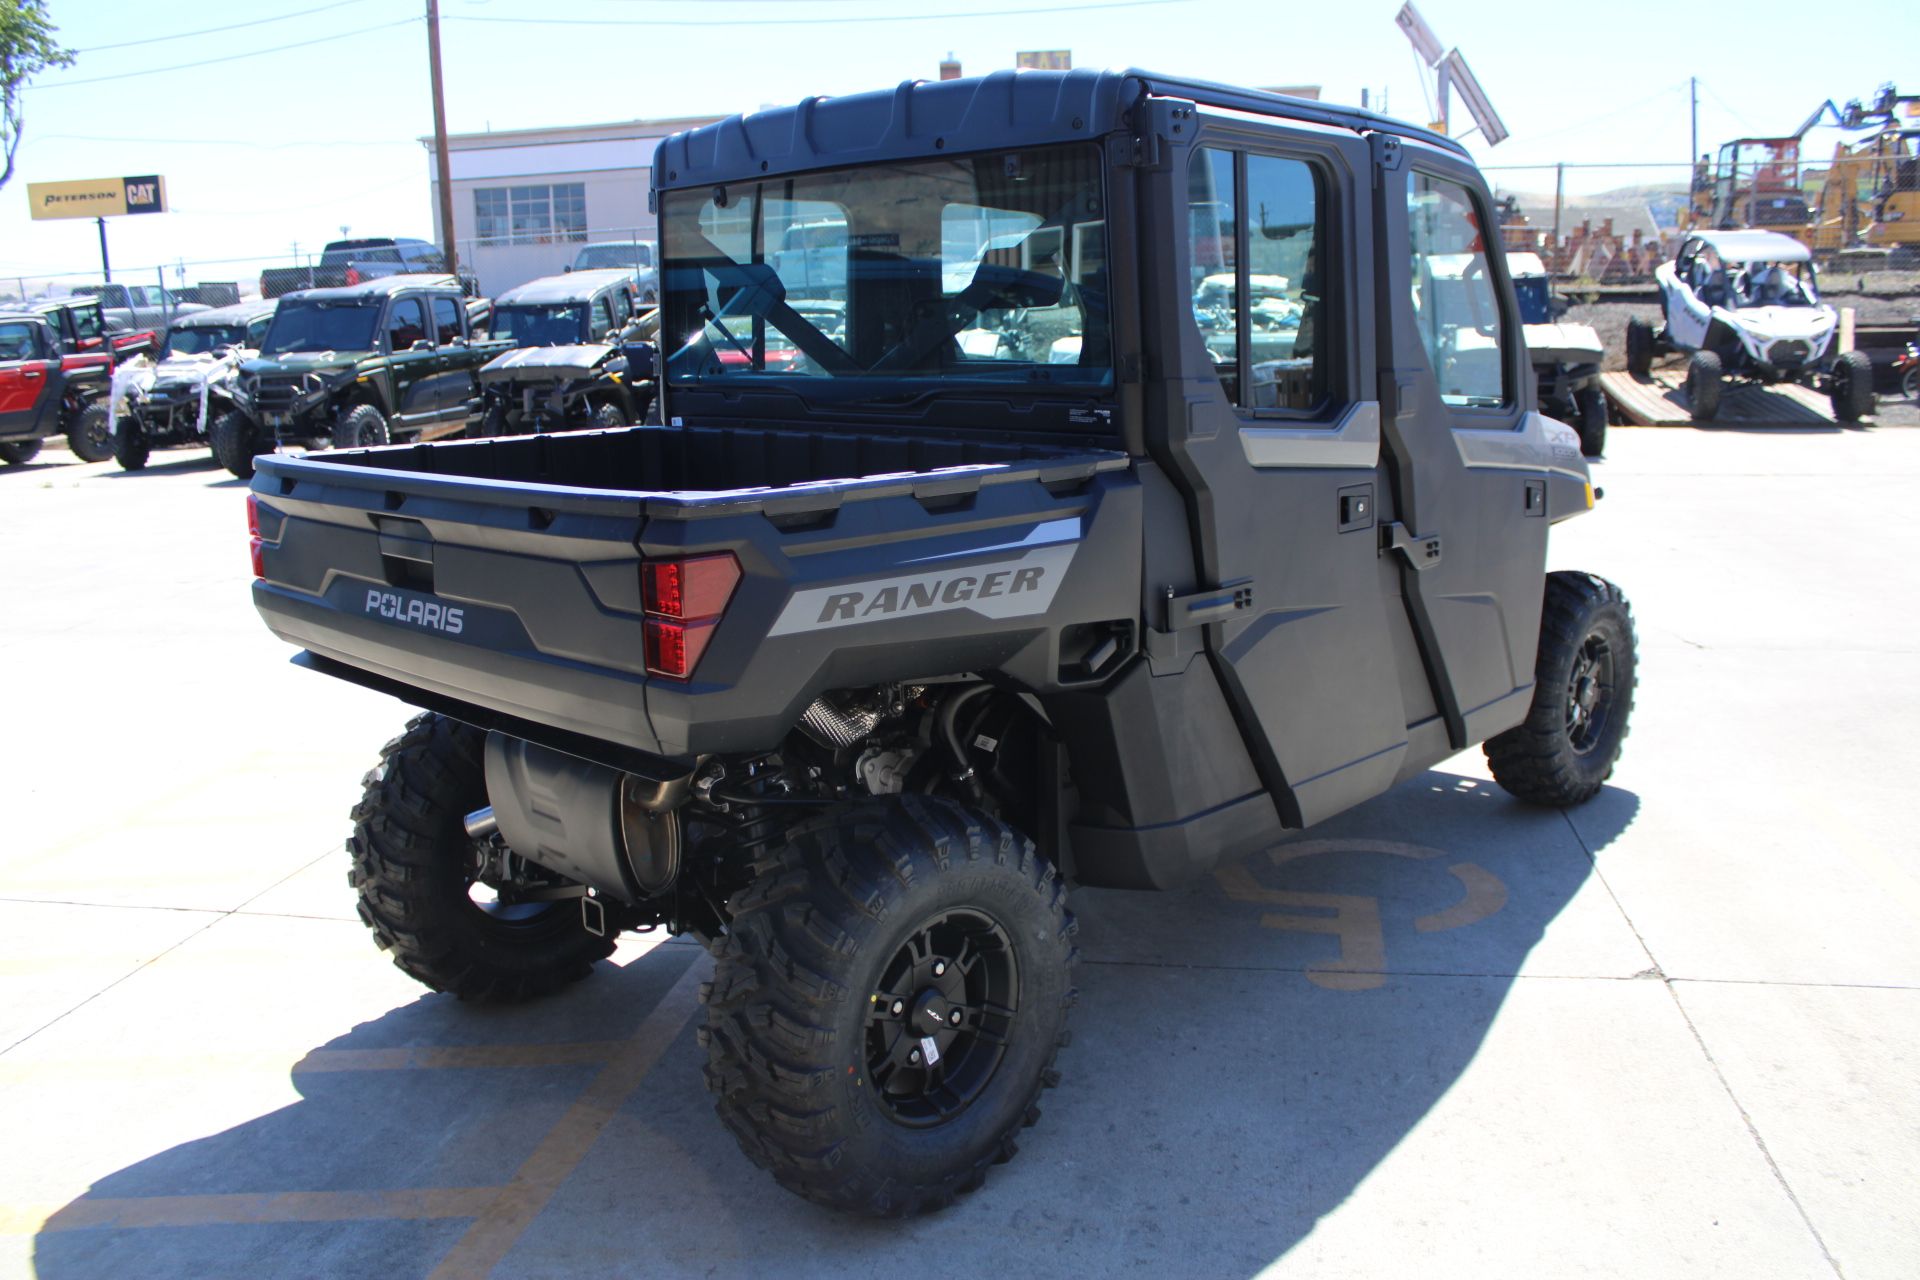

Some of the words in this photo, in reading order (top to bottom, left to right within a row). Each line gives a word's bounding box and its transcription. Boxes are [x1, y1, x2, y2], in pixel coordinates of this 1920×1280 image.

[45, 192, 116, 206] PETERSON
[127, 184, 155, 205] CAT
[365, 589, 464, 634] POLARIS
[816, 566, 1046, 623] RANGER
